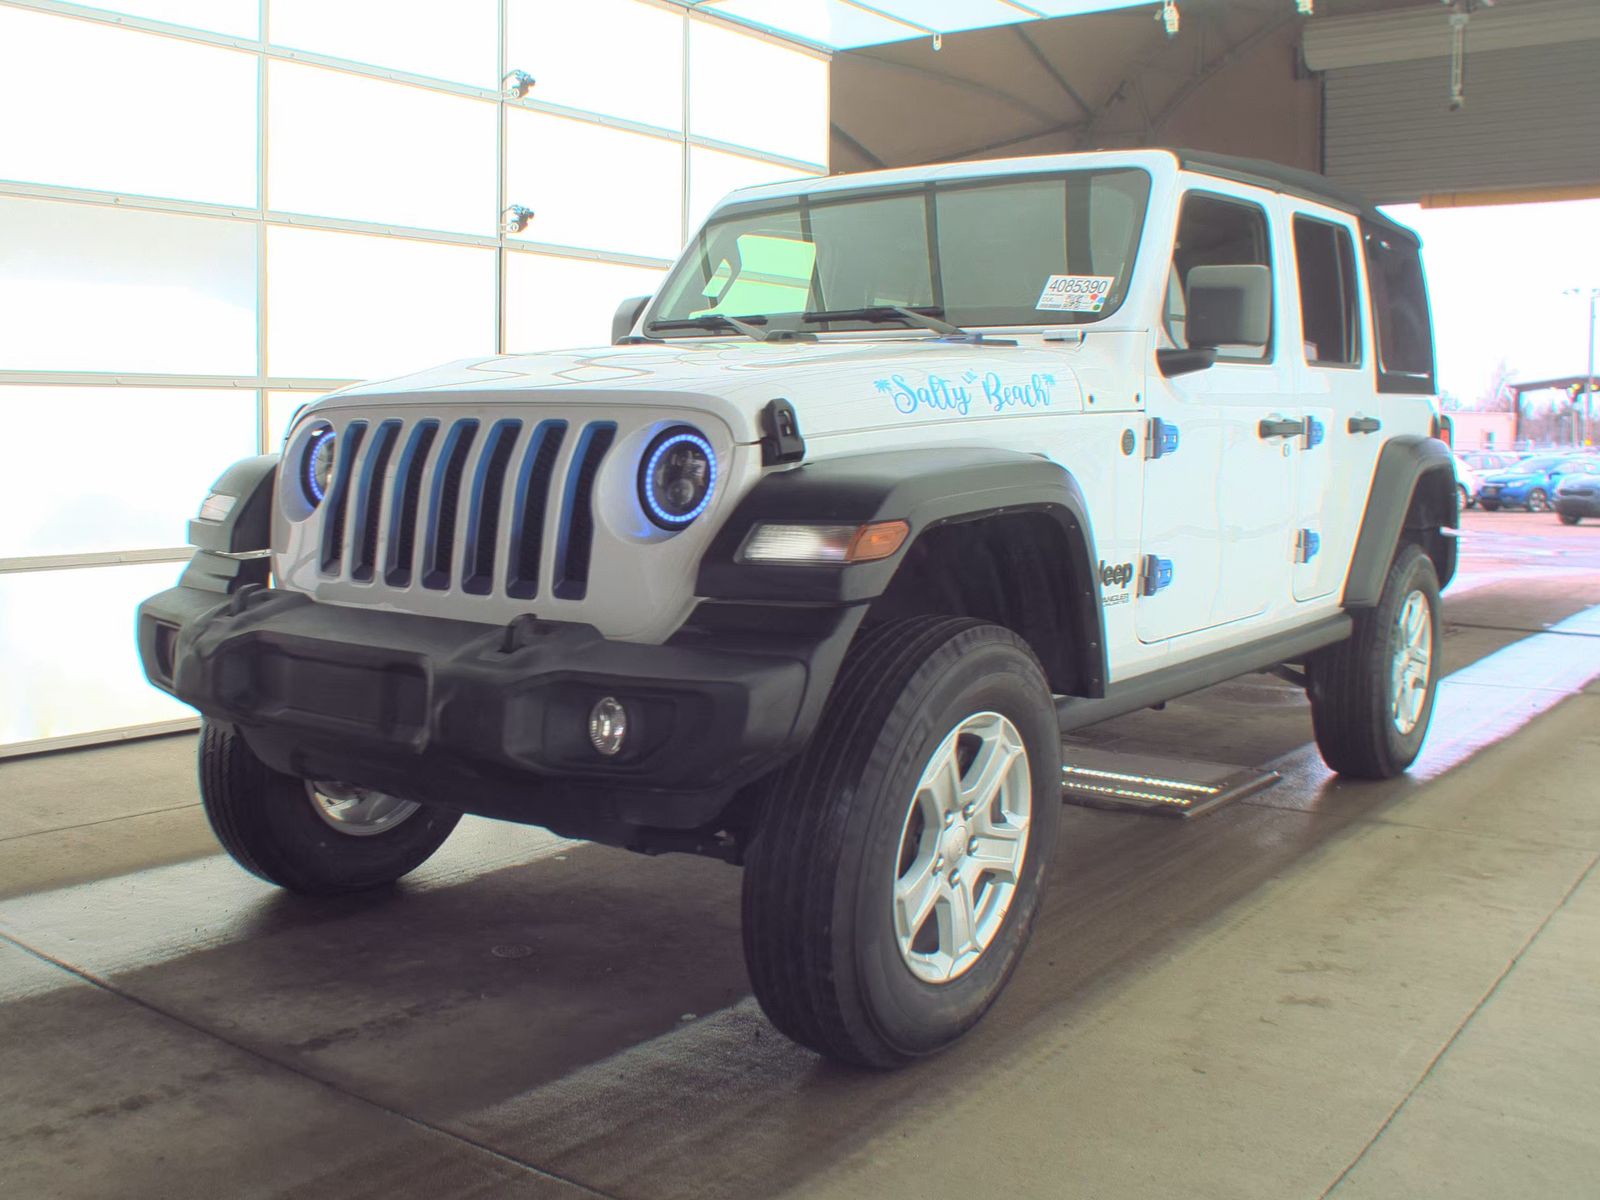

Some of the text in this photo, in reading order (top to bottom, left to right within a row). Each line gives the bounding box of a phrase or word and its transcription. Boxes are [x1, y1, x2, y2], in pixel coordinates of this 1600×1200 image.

[1048, 279, 1108, 294] 4085390
[891, 374, 972, 416] Salty
[982, 371, 1051, 412] Beach
